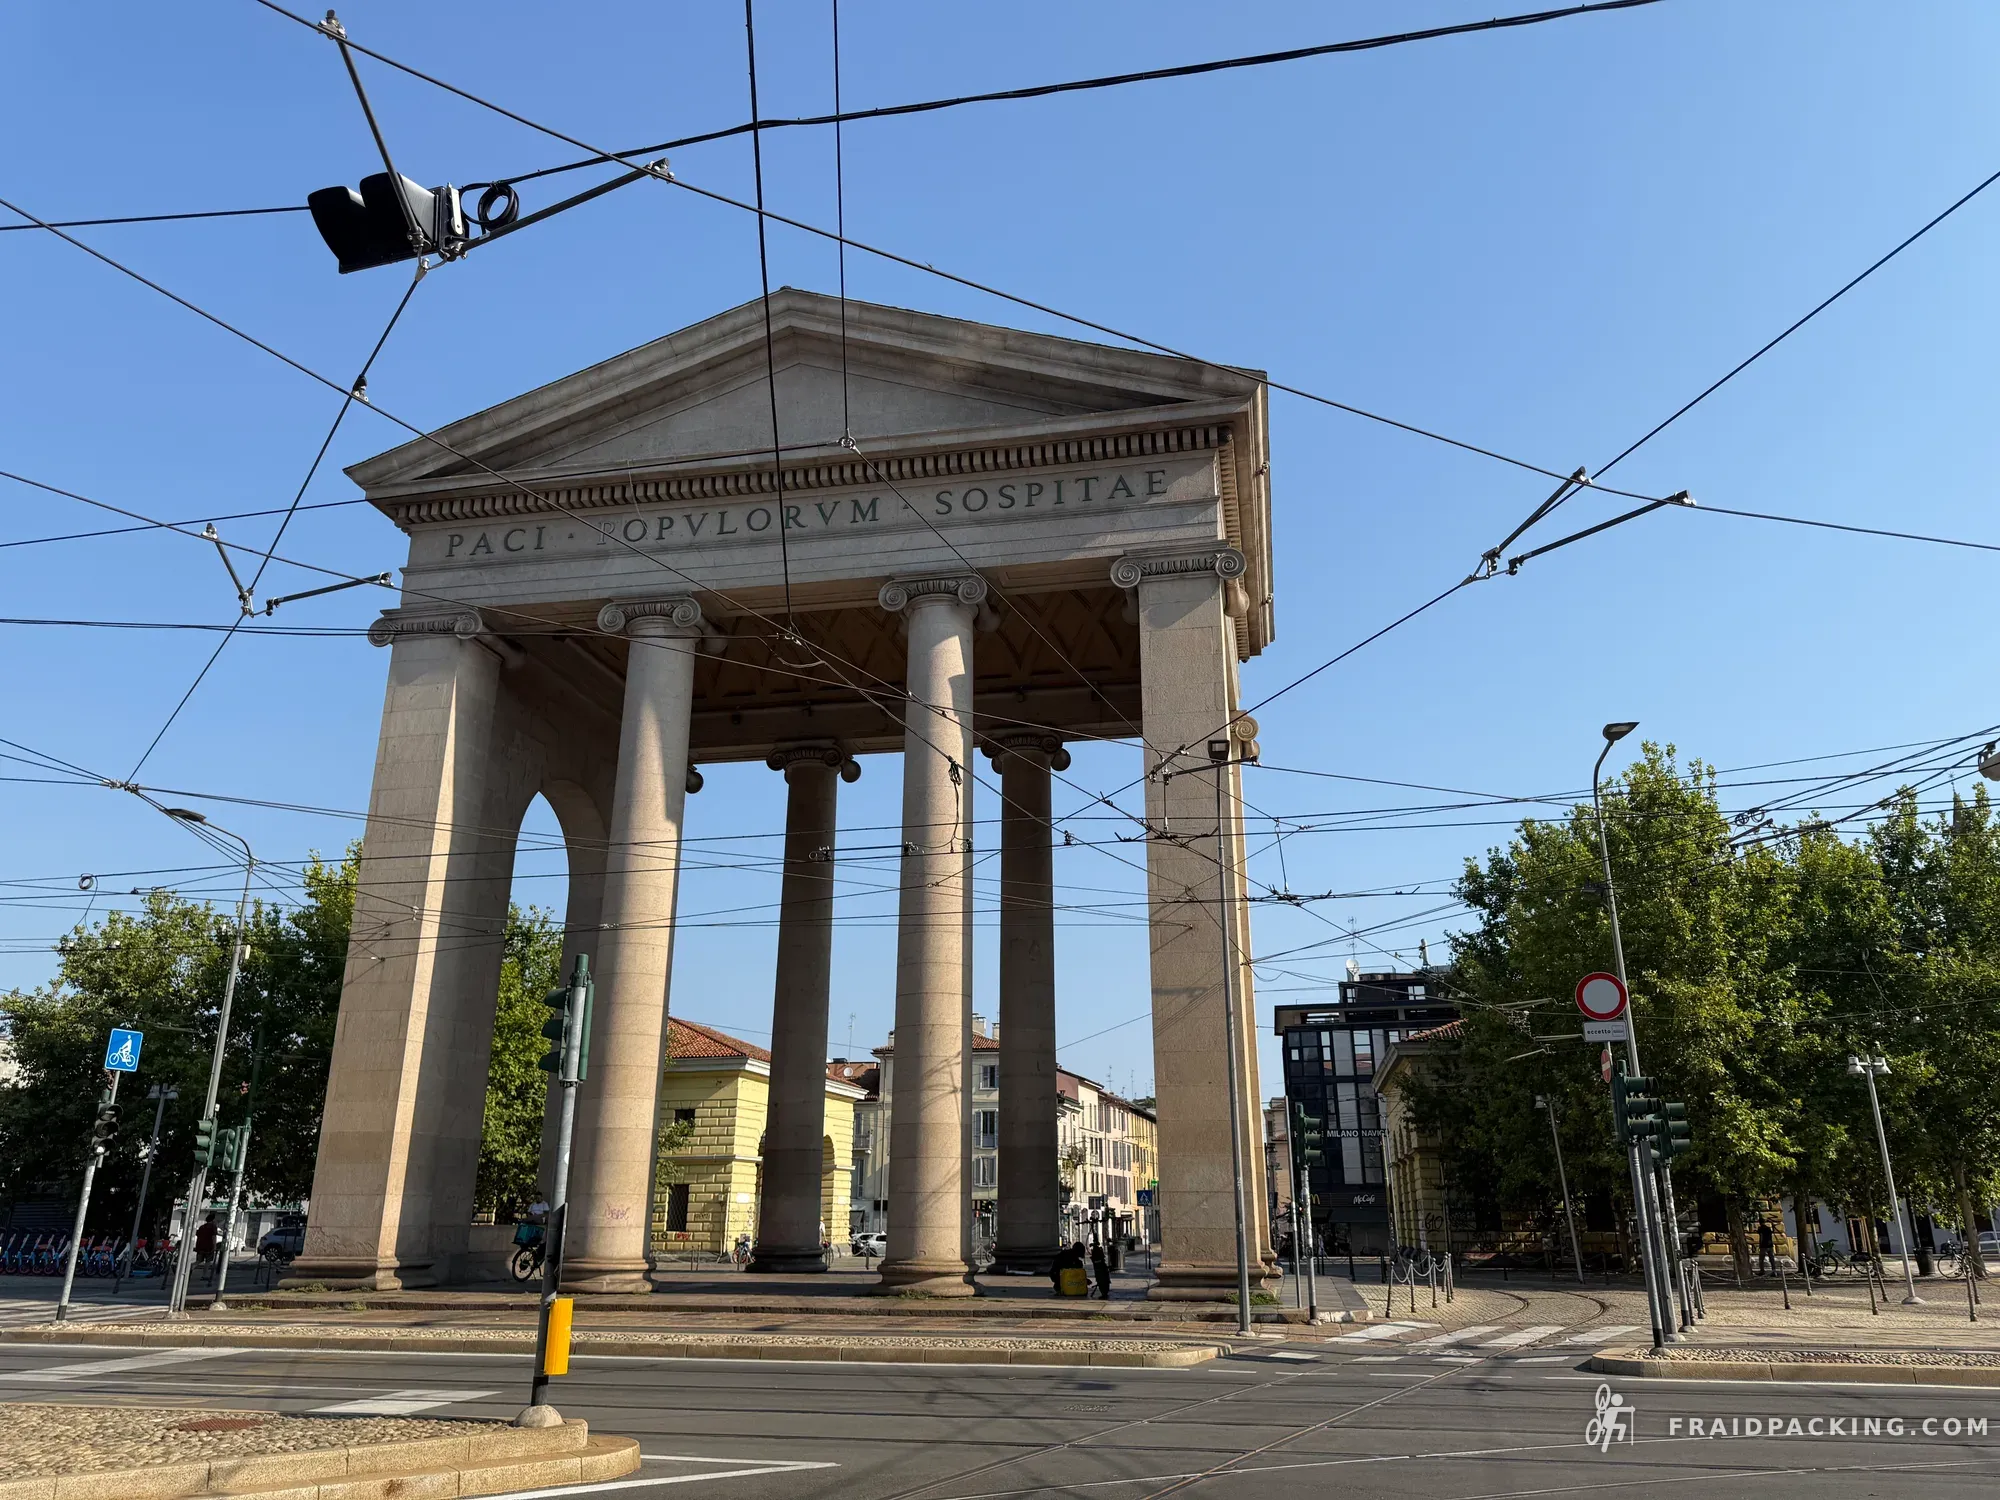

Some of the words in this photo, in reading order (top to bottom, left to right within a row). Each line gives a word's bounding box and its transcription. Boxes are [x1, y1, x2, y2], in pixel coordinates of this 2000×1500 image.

[446, 526, 545, 559] PACI
[597, 498, 880, 547] POPVLORVM
[934, 468, 1168, 515] SOSPITAE
[1326, 1129, 1359, 1138] MILANO
